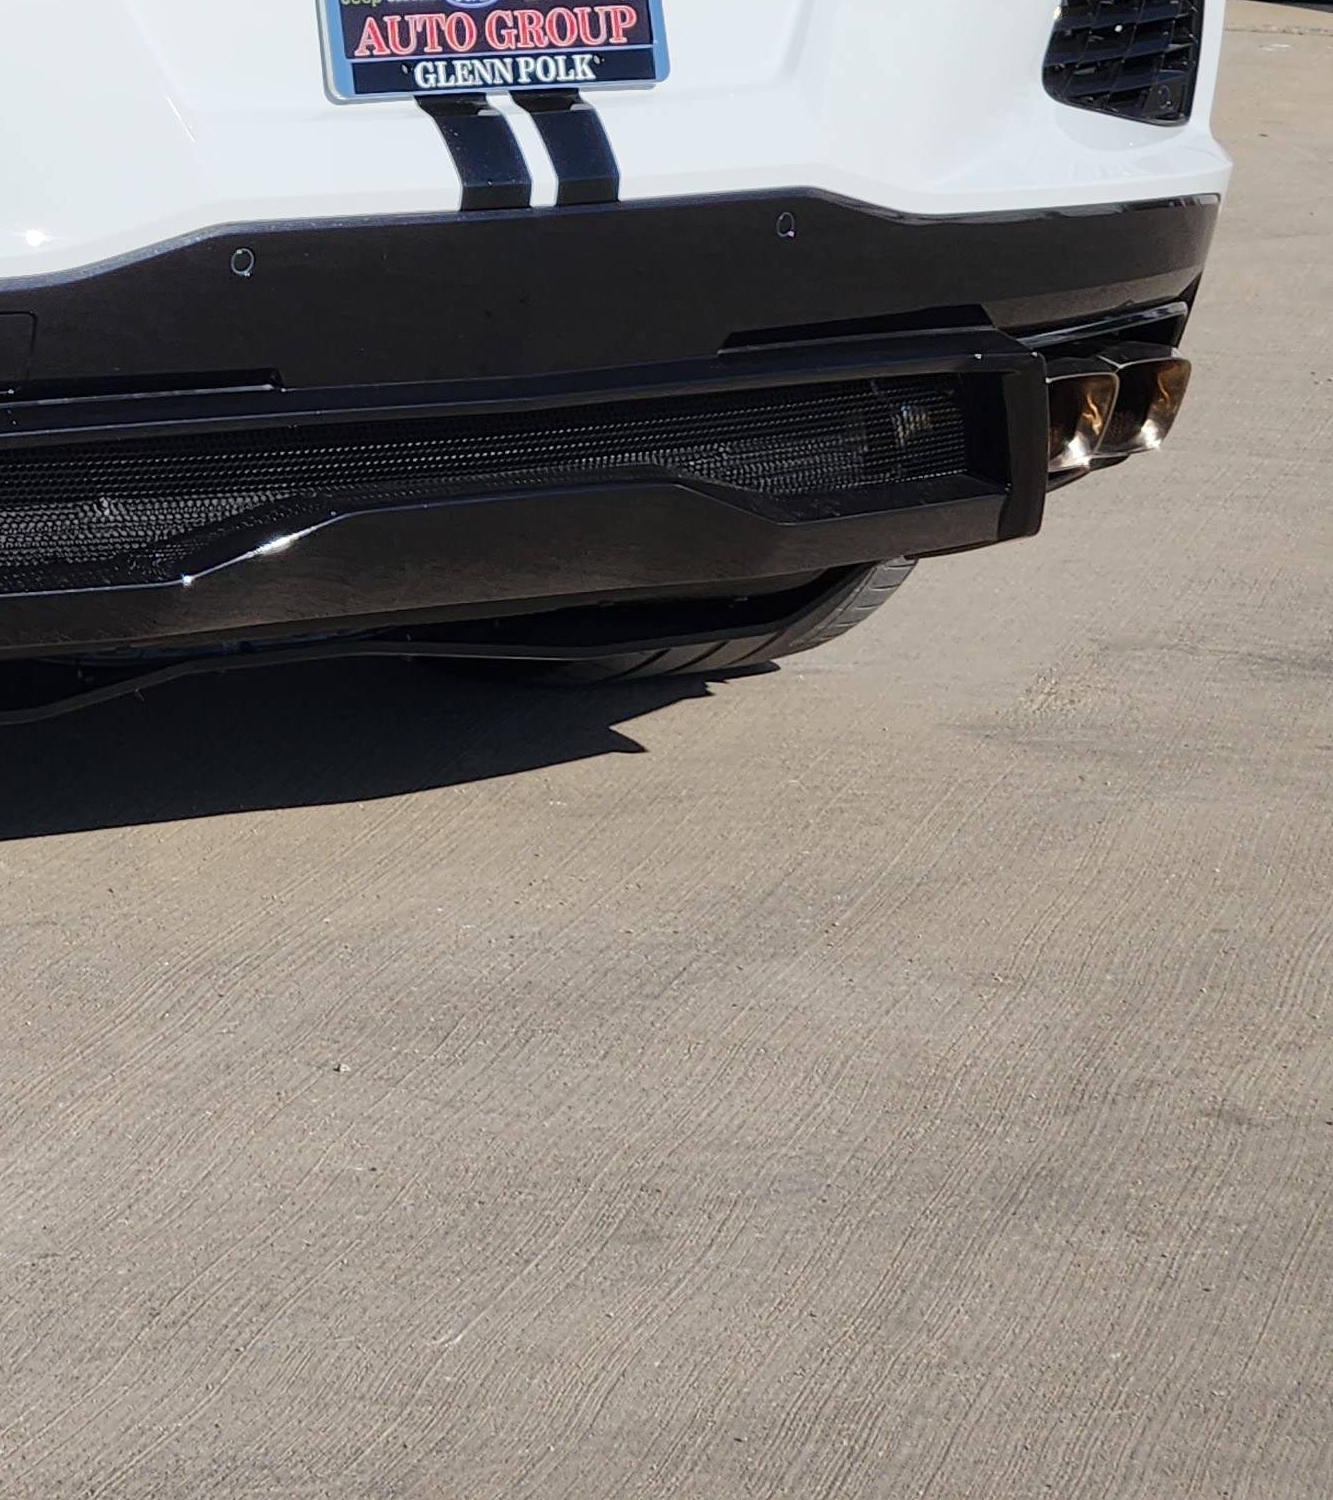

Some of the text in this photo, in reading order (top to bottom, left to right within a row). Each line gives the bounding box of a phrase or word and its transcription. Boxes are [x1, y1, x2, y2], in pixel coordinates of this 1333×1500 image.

[354, 5, 637, 57] AUTO GROUP
[414, 54, 596, 88] GLENN POLK
